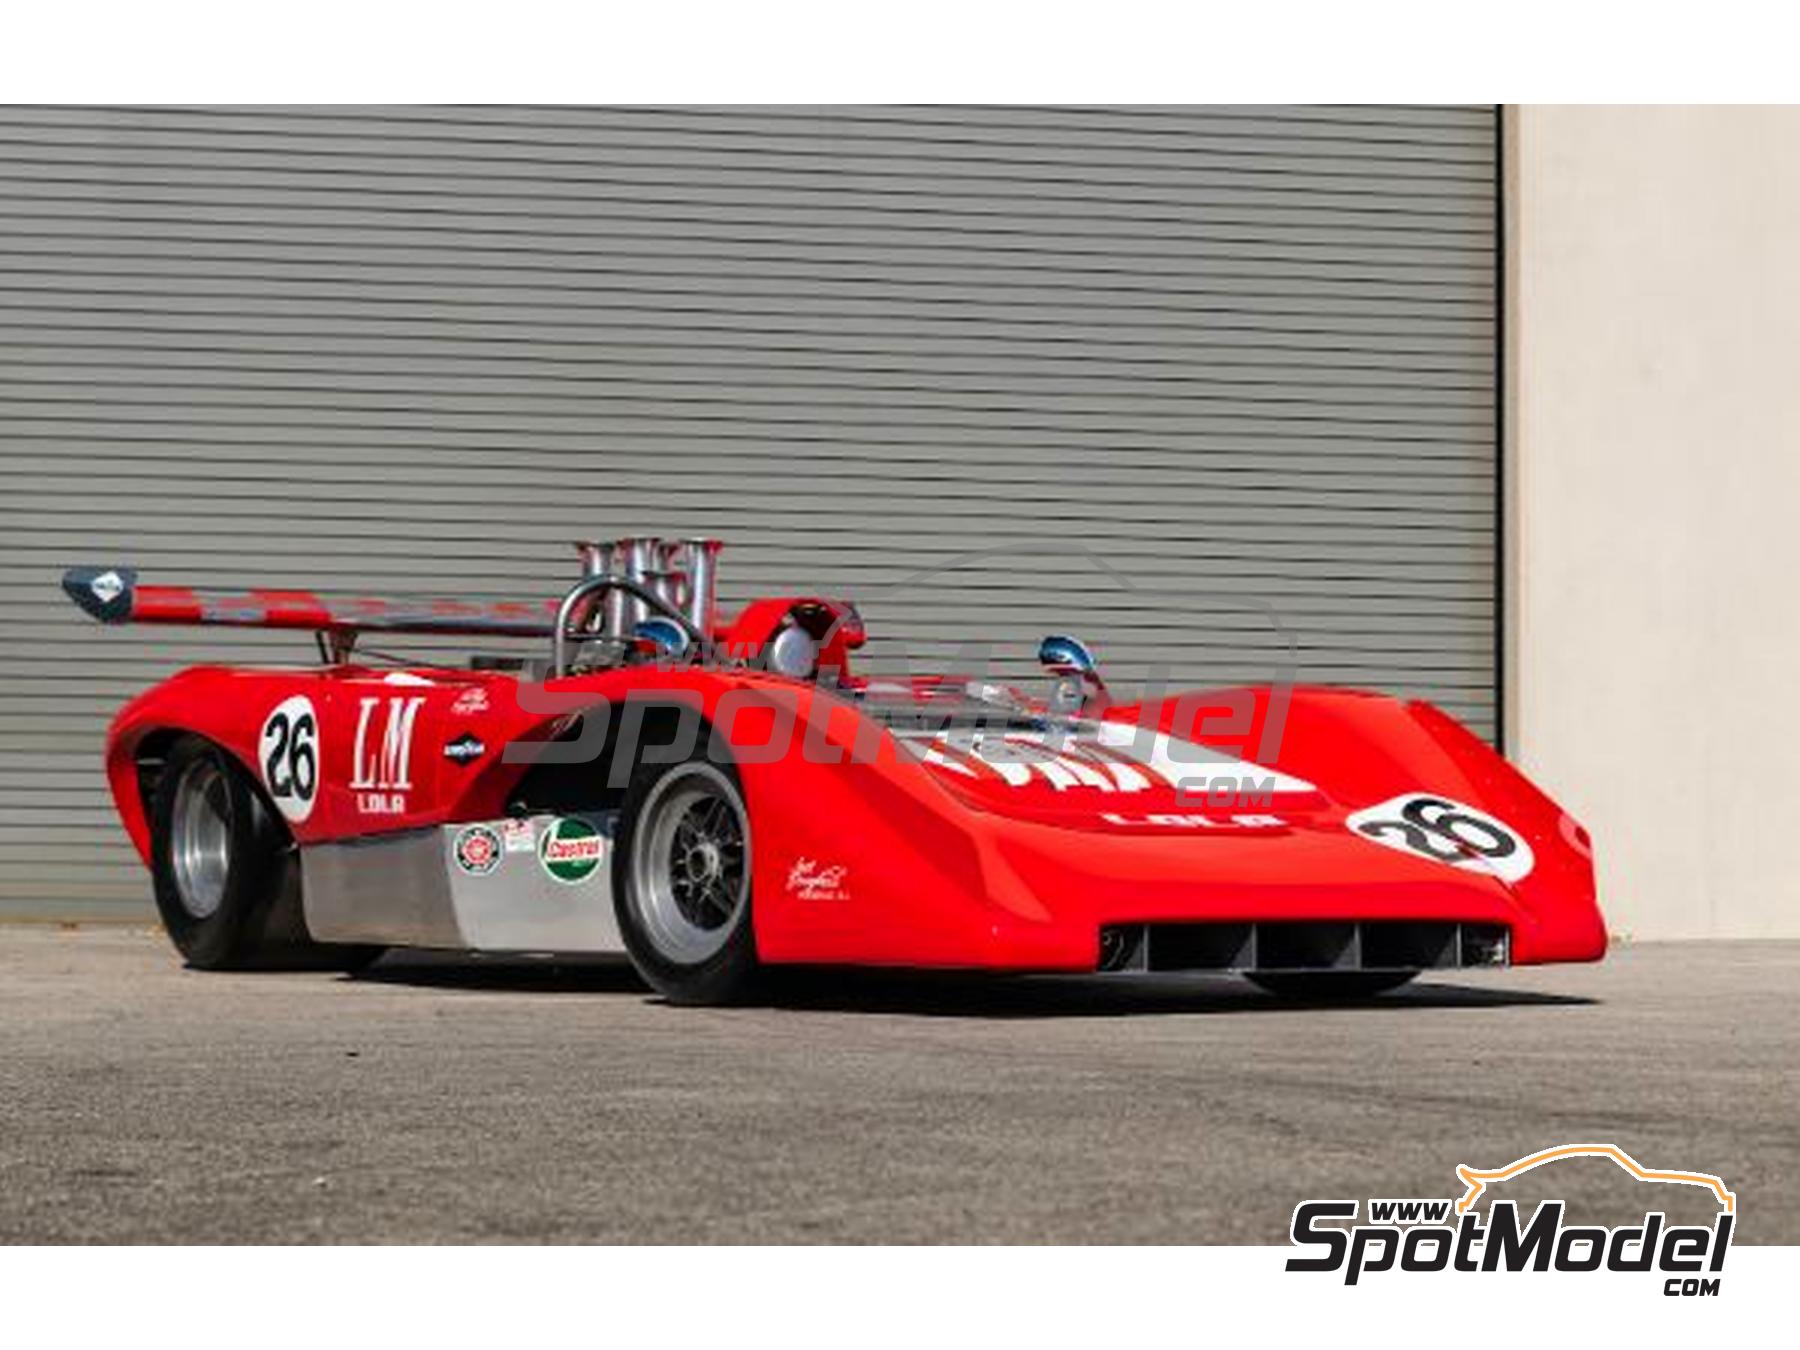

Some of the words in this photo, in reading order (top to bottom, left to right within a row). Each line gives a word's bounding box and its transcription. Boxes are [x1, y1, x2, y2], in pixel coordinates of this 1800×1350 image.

[266, 712, 316, 801] 26
[349, 697, 427, 790] LM
[1358, 798, 1516, 864] 26
